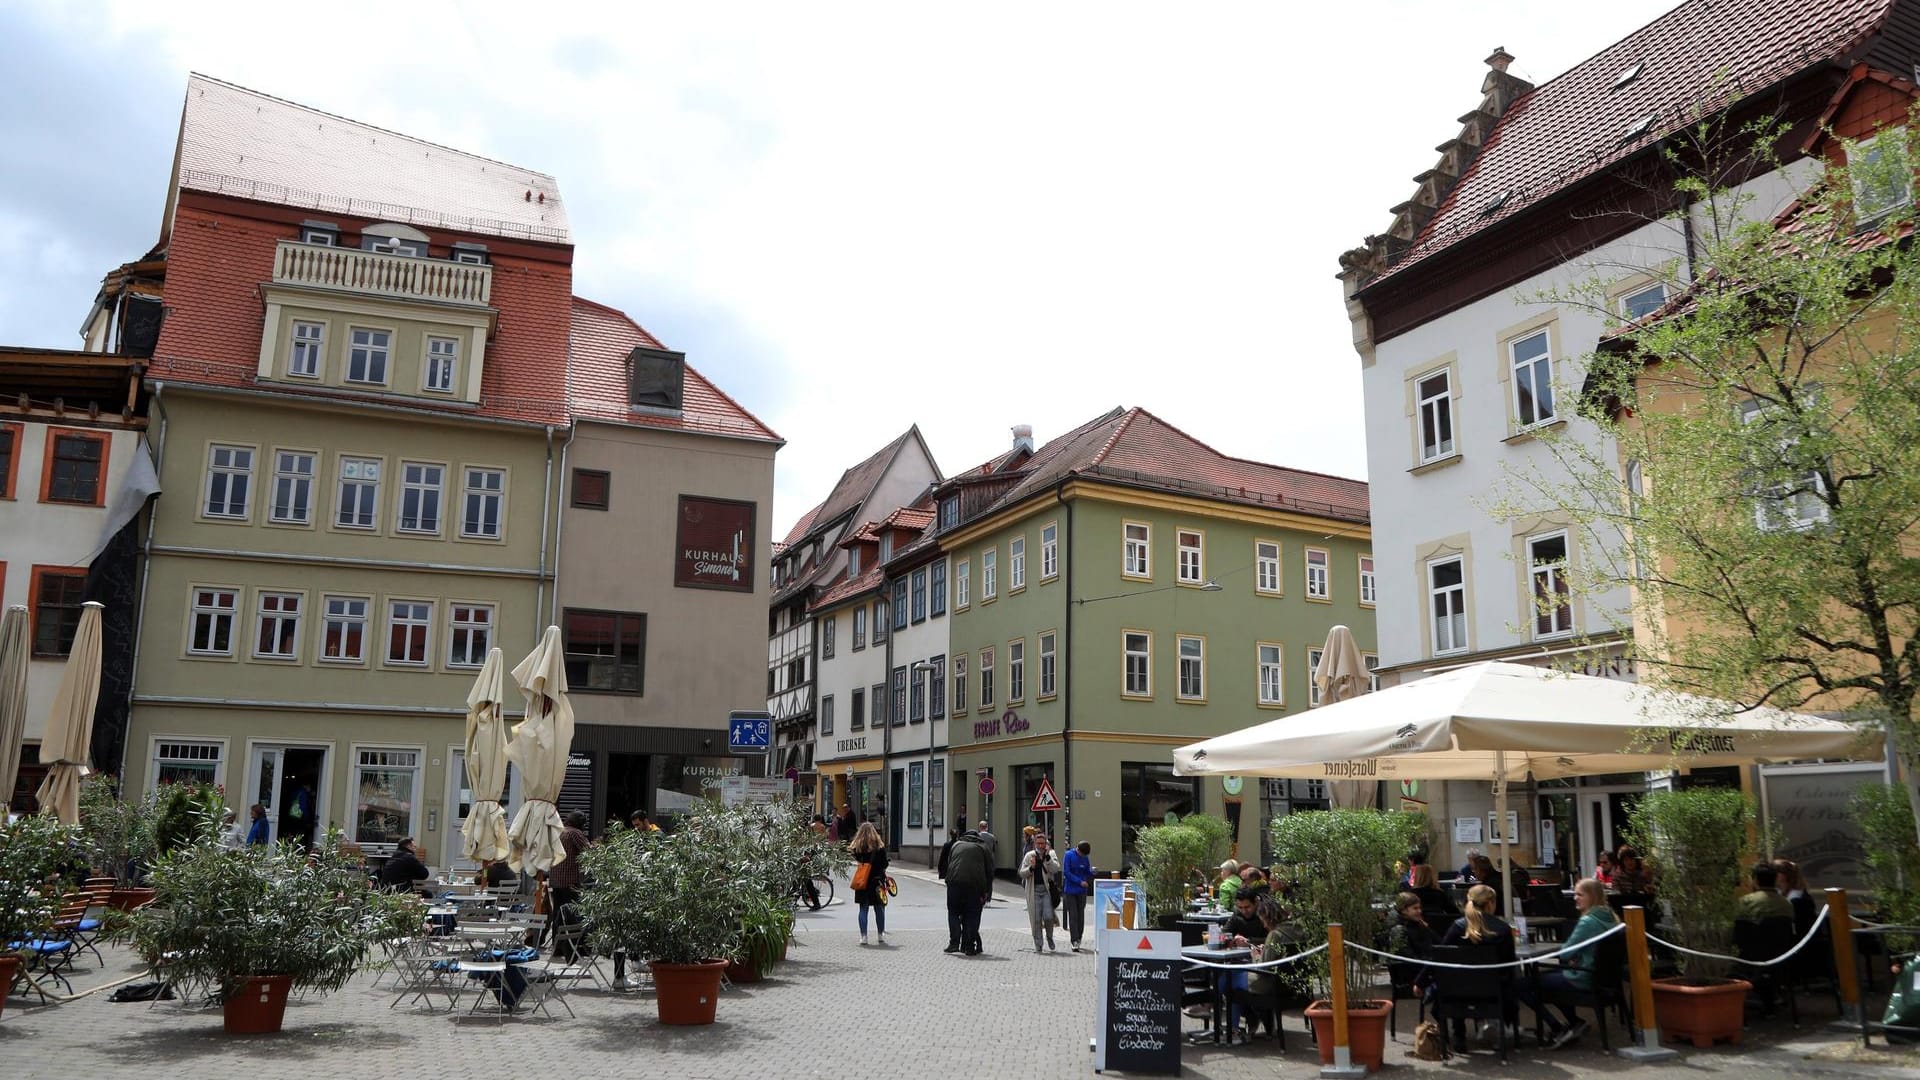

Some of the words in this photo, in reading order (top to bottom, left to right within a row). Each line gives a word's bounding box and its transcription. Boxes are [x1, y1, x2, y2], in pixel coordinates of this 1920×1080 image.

[685, 549, 744, 563] KURHAUS
[694, 561, 734, 576] Simone
[682, 766, 739, 777] KURHAUS
[700, 777, 721, 790] Sim
[1126, 1012, 1148, 1023] sowie
[1113, 1020, 1169, 1035] verschiedene
[1118, 1035, 1165, 1050] Eisbecher
